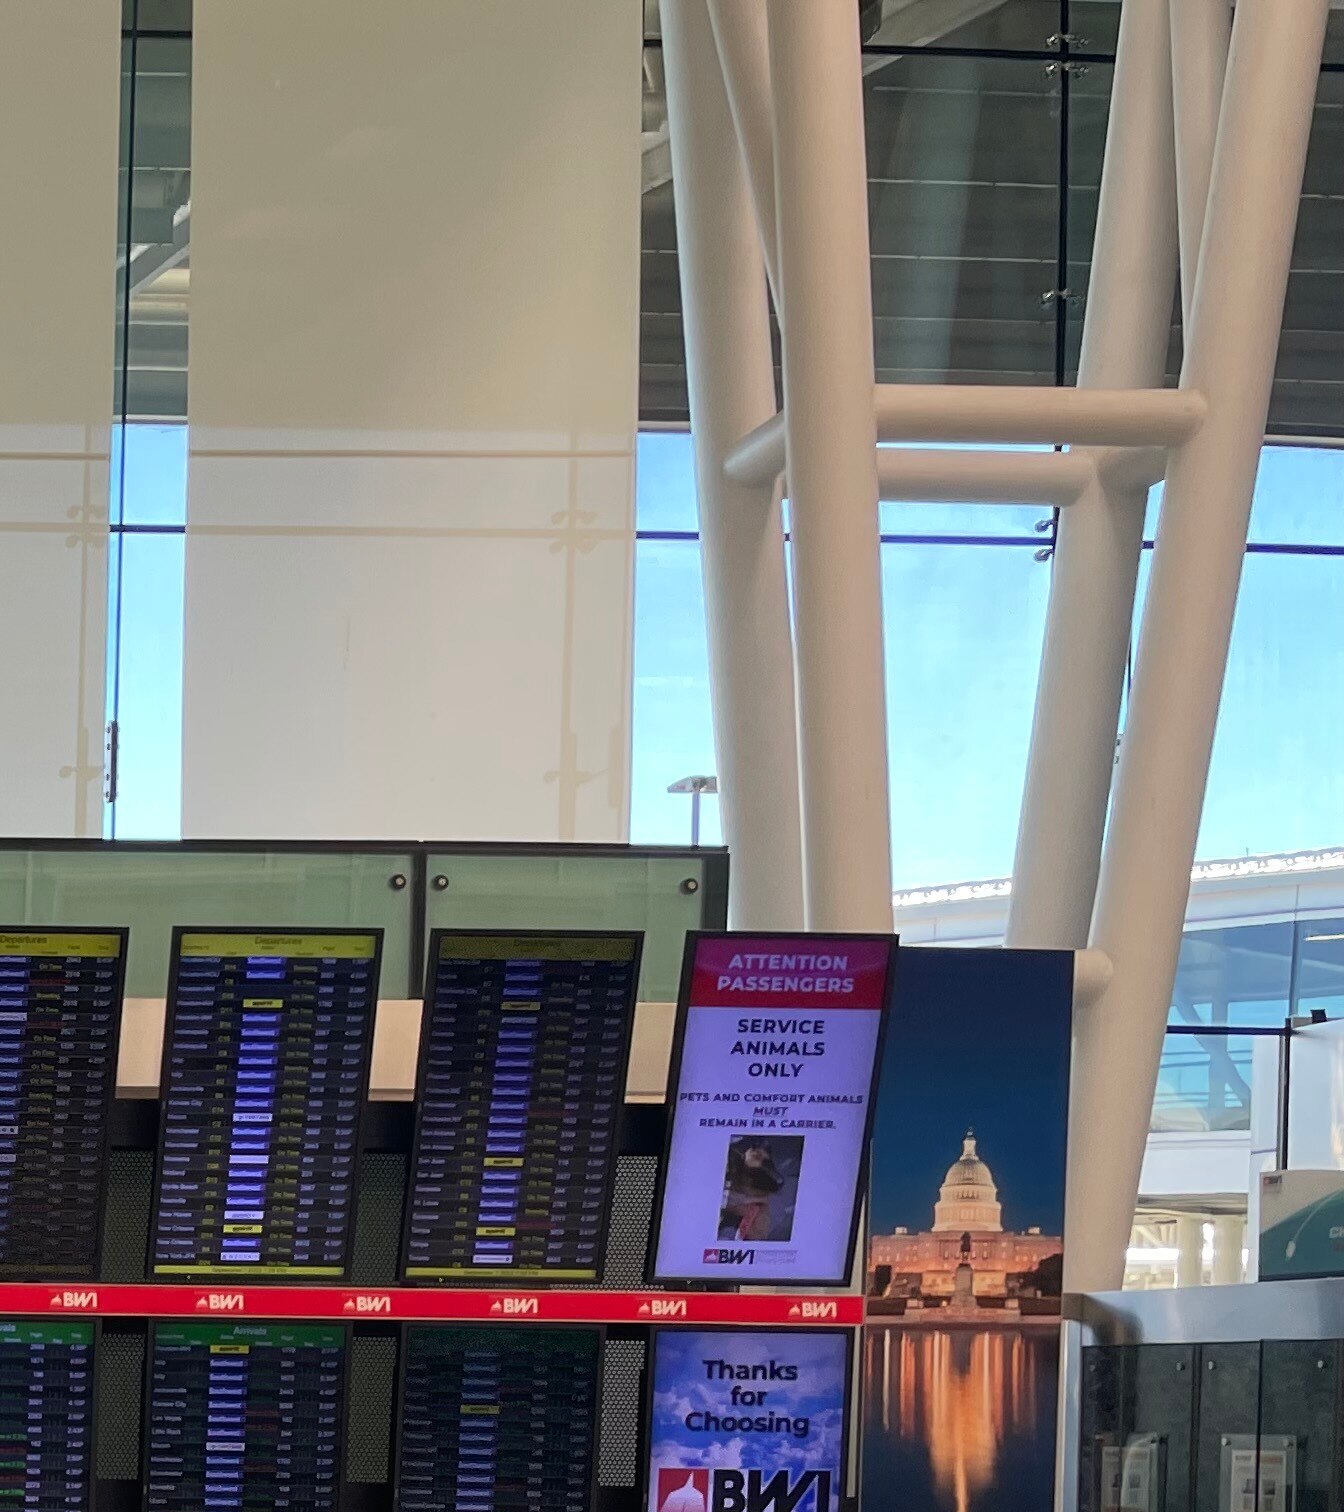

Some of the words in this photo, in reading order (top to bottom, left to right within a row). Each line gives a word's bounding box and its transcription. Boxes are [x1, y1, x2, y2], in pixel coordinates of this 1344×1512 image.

[254, 936, 303, 946] Departures
[728, 954, 848, 971] ATTENTION
[717, 977, 854, 994] PASSENGERS
[738, 1018, 824, 1035] SERVICE
[730, 1041, 825, 1056] ANIMALS
[747, 1062, 804, 1078] ONLY
[679, 1092, 710, 1104] PETS
[712, 1092, 740, 1103] AND
[744, 1093, 805, 1104] COMFORT
[808, 1094, 863, 1105] ANIMALS
[753, 1106, 788, 1117] MUST
[698, 1118, 748, 1129] REMAIN
[752, 1118, 764, 1129] IN
[768, 1119, 777, 1129] A
[780, 1119, 836, 1130] CARRIER.
[718, 1250, 755, 1265] BWI
[63, 1292, 98, 1308] BWI
[209, 1295, 244, 1310] BWI
[356, 1297, 391, 1312] BWI
[503, 1298, 538, 1314] BWI
[651, 1300, 687, 1316] BWI
[801, 1302, 837, 1318] BWI
[702, 1359, 798, 1381] Thanks
[730, 1386, 768, 1406] for
[685, 1412, 810, 1438] Choosing
